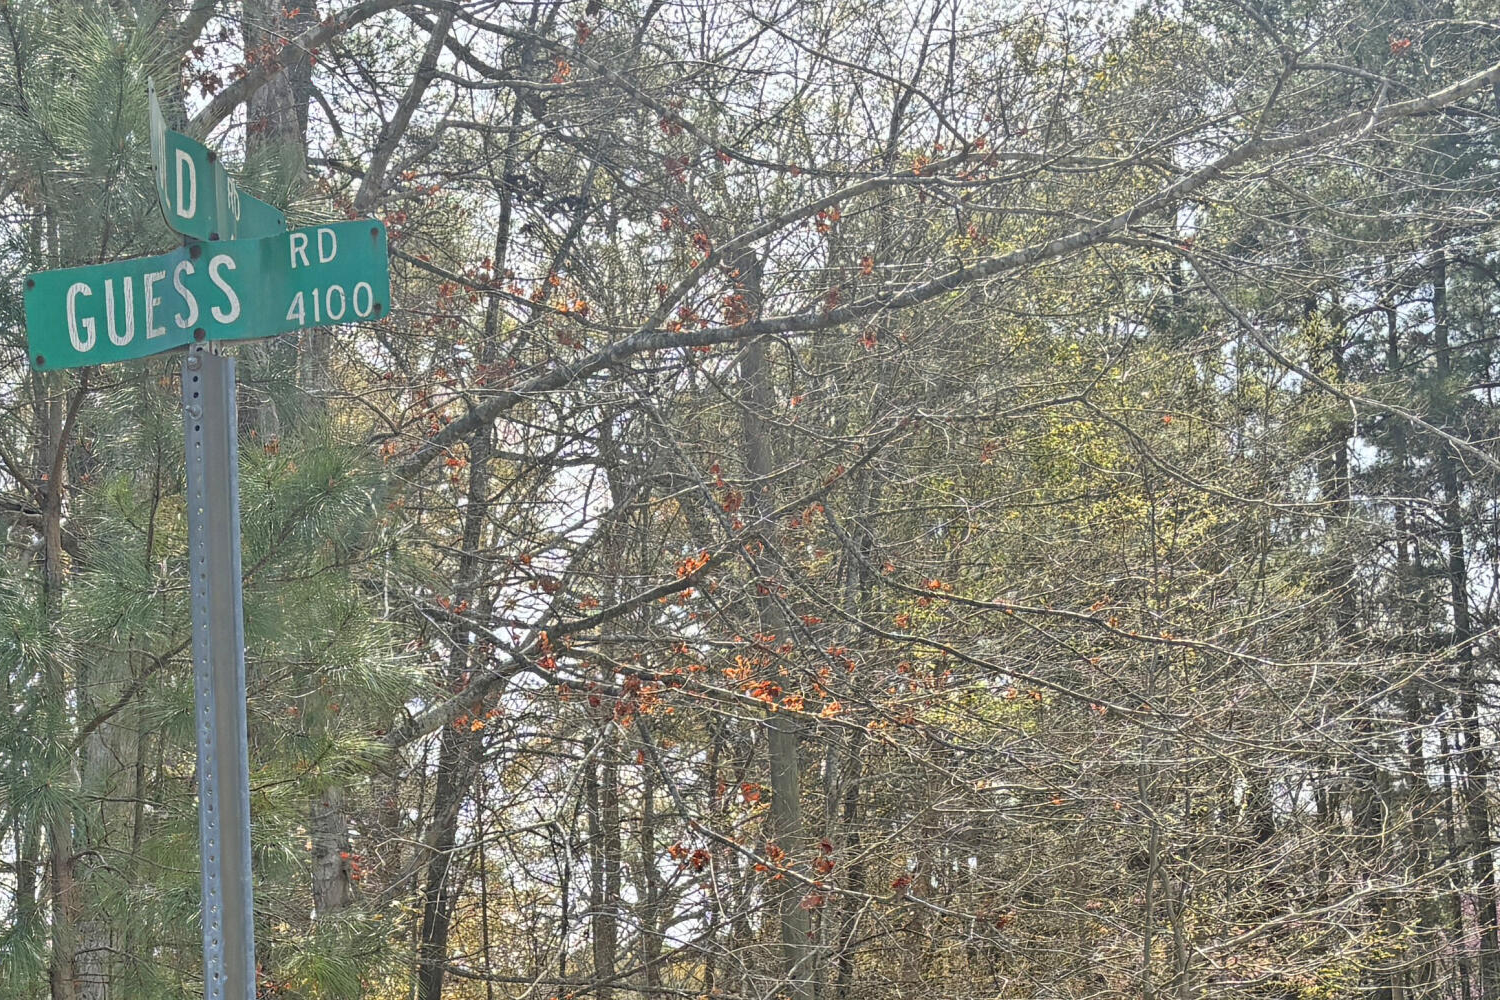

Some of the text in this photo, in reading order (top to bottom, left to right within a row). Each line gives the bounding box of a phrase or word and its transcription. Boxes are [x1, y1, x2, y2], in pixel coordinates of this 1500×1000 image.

[66, 228, 338, 353] GUESS RD
[286, 281, 374, 325] 4100
